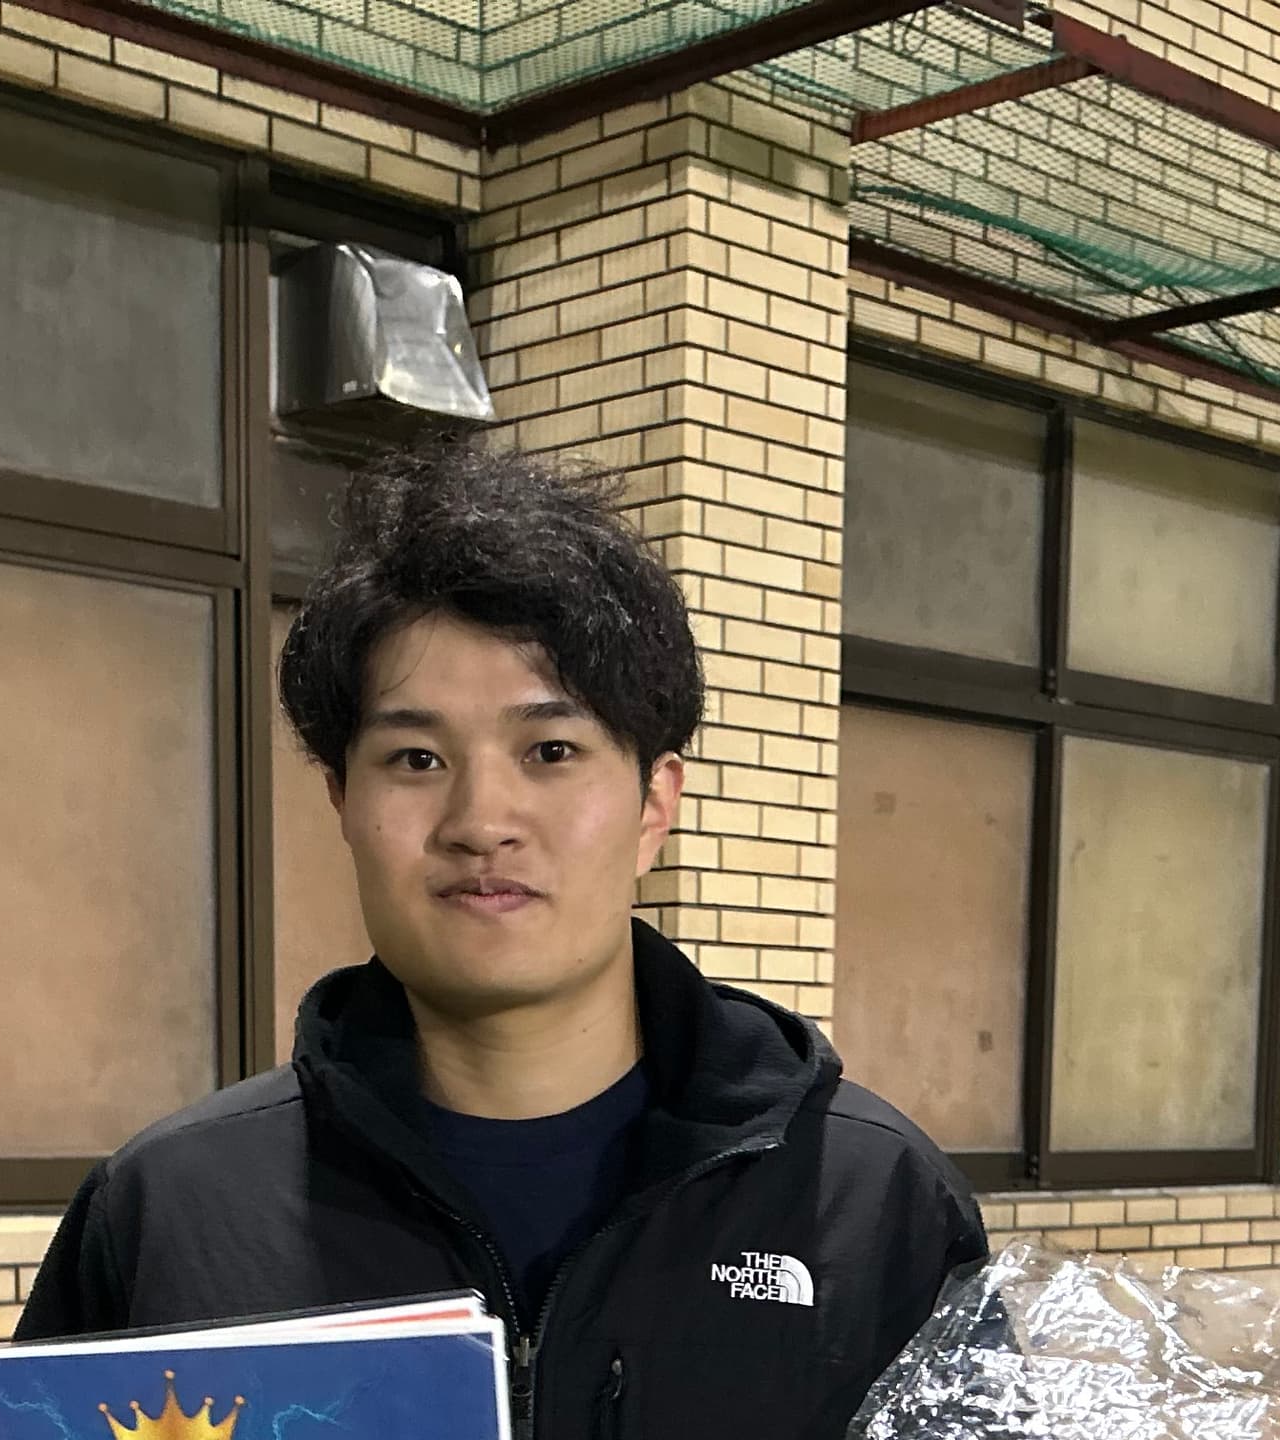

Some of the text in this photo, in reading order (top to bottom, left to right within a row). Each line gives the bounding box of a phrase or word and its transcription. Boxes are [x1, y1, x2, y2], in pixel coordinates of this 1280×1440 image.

[740, 1252, 781, 1270] THE
[711, 1263, 781, 1285] NORTH
[730, 1282, 781, 1301] FACE
